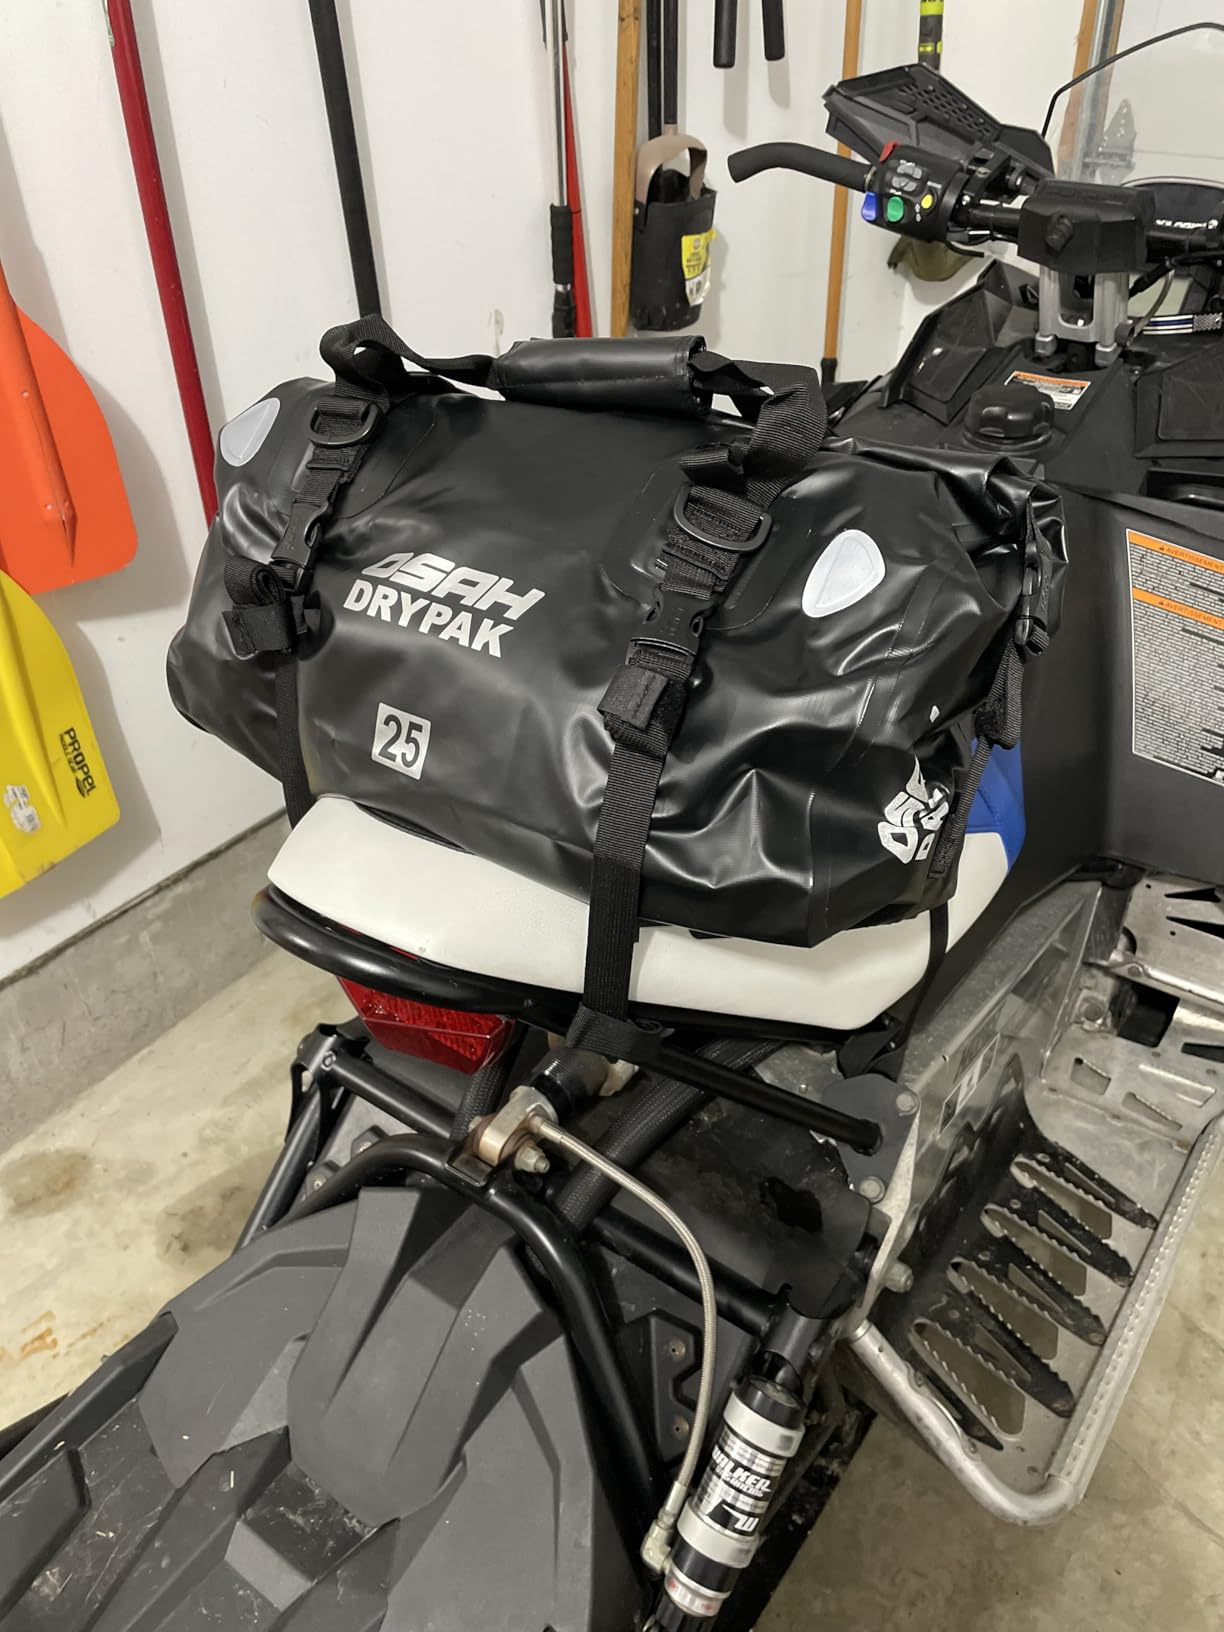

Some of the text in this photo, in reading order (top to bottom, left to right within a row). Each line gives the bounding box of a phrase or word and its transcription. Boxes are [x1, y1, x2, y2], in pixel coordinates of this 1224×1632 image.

[343, 579, 514, 658] DRYPAK
[361, 552, 546, 621] OSAH
[377, 713, 424, 768] 25
